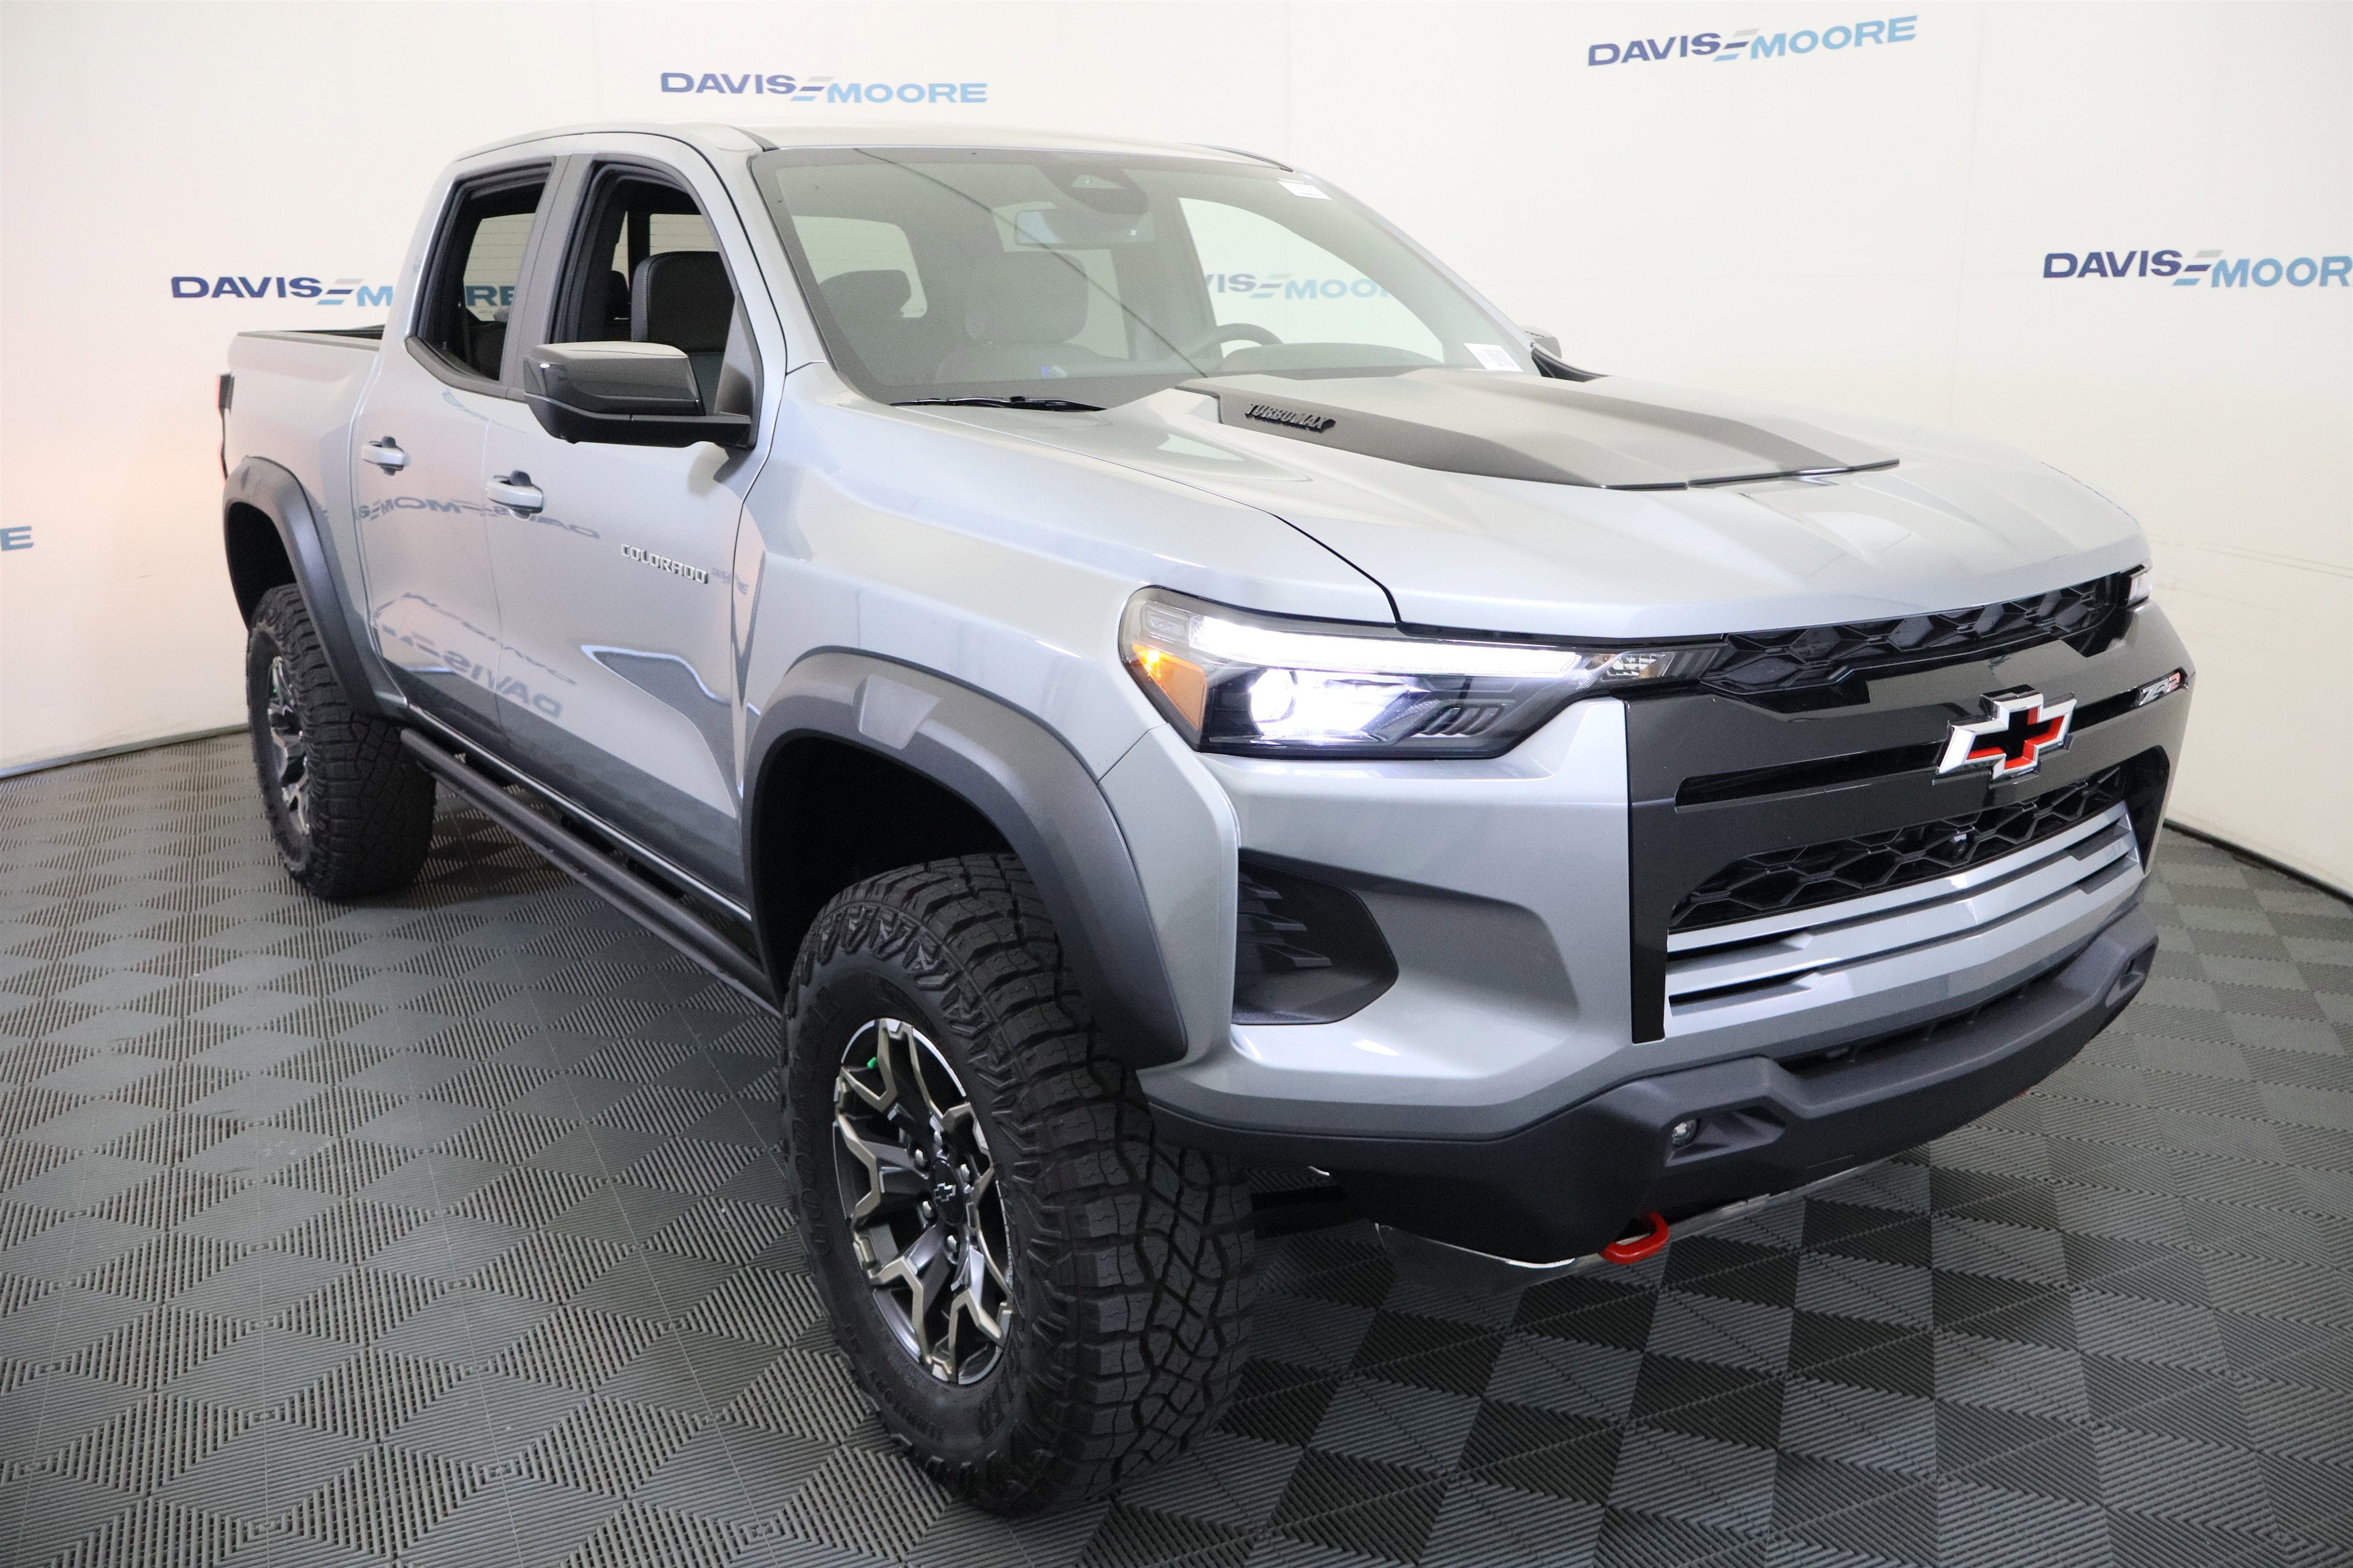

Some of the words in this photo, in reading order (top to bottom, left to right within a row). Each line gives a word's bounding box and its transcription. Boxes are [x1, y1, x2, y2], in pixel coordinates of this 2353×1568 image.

[1588, 32, 1722, 67] DAVIS
[1750, 14, 1918, 60] MOORE
[661, 72, 797, 94] DAVIS
[827, 83, 988, 104] MOORE
[2043, 249, 2183, 279] DAVIS
[2211, 255, 2353, 287] MOOR
[172, 276, 322, 299] DAVIS
[1245, 403, 1336, 433] TURBOMAX
[620, 543, 708, 584] COLORADO
[2138, 672, 2181, 706] ZR2
